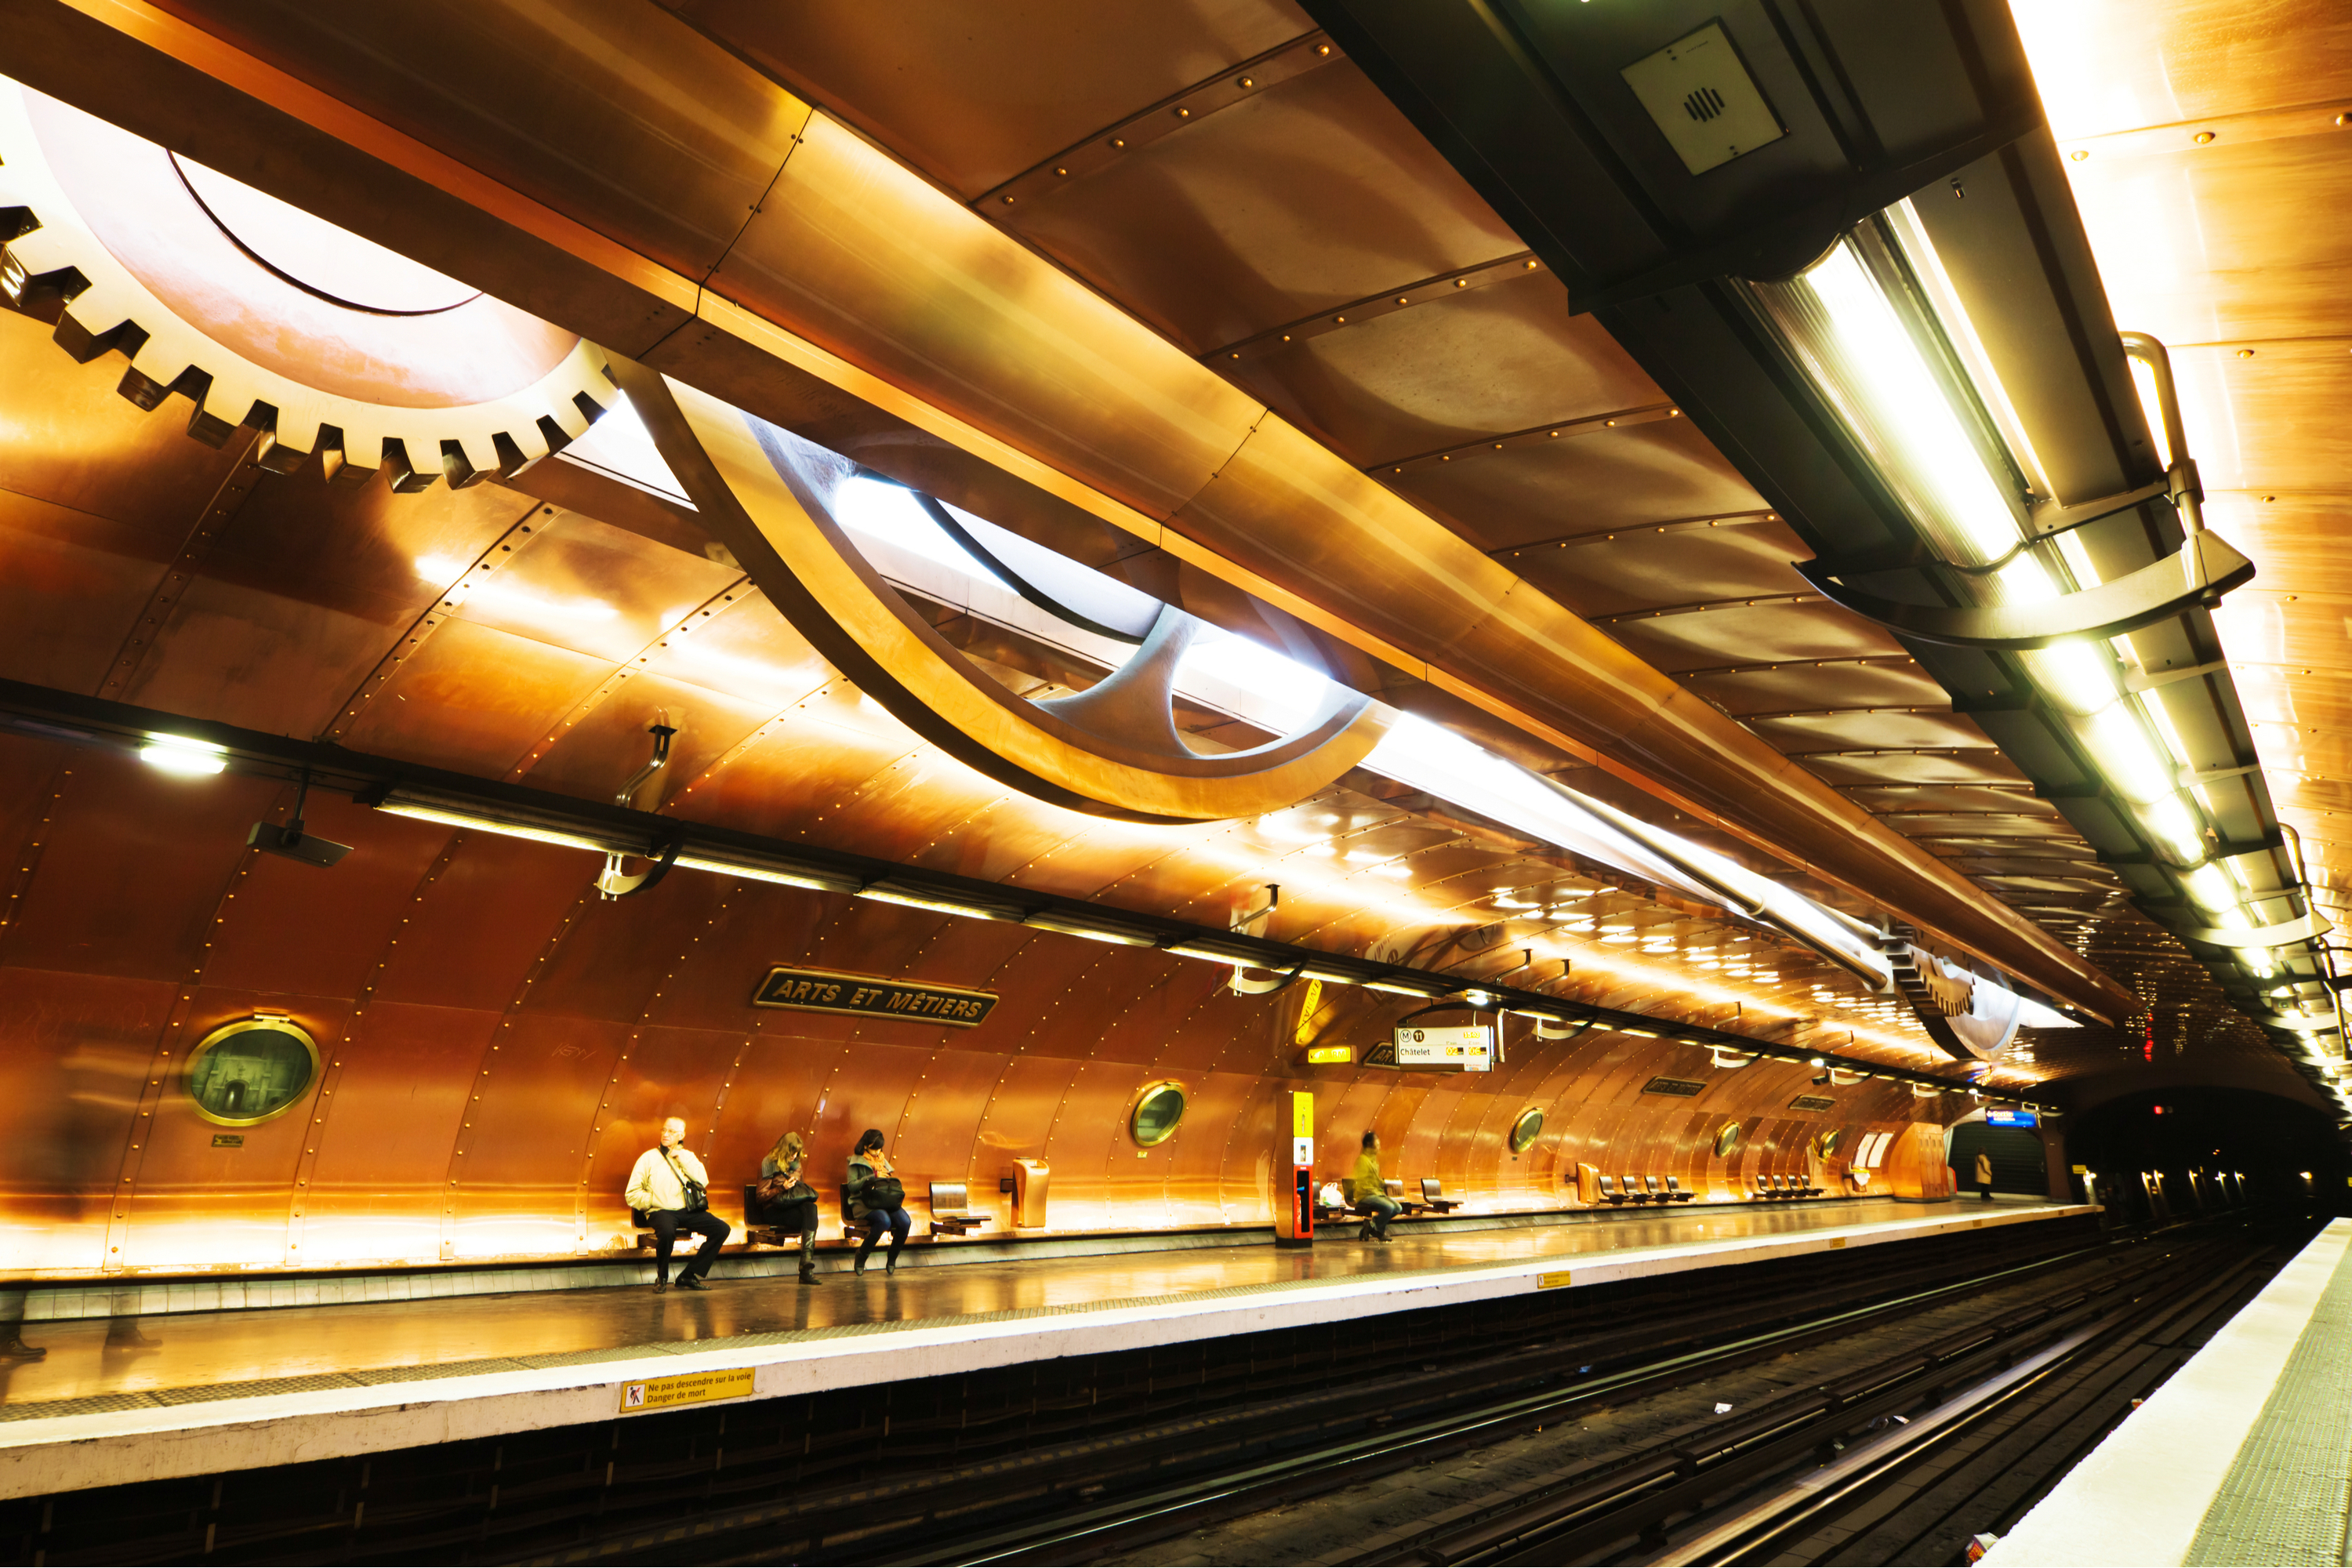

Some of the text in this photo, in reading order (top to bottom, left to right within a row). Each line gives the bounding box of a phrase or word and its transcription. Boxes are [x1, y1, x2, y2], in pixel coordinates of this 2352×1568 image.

[772, 979, 982, 1018] ARTS ET MÉTIERS
[1414, 1031, 1424, 1041] 11
[1319, 1051, 1350, 1060] ALARME
[1400, 1047, 1431, 1056] Châtelet
[1446, 1046, 1457, 1055] 02
[648, 1384, 659, 1392] Ne
[661, 1382, 674, 1392] pas
[676, 1377, 713, 1388] descendre
[736, 1372, 751, 1381] voie
[647, 1388, 706, 1403] Danger de mort
